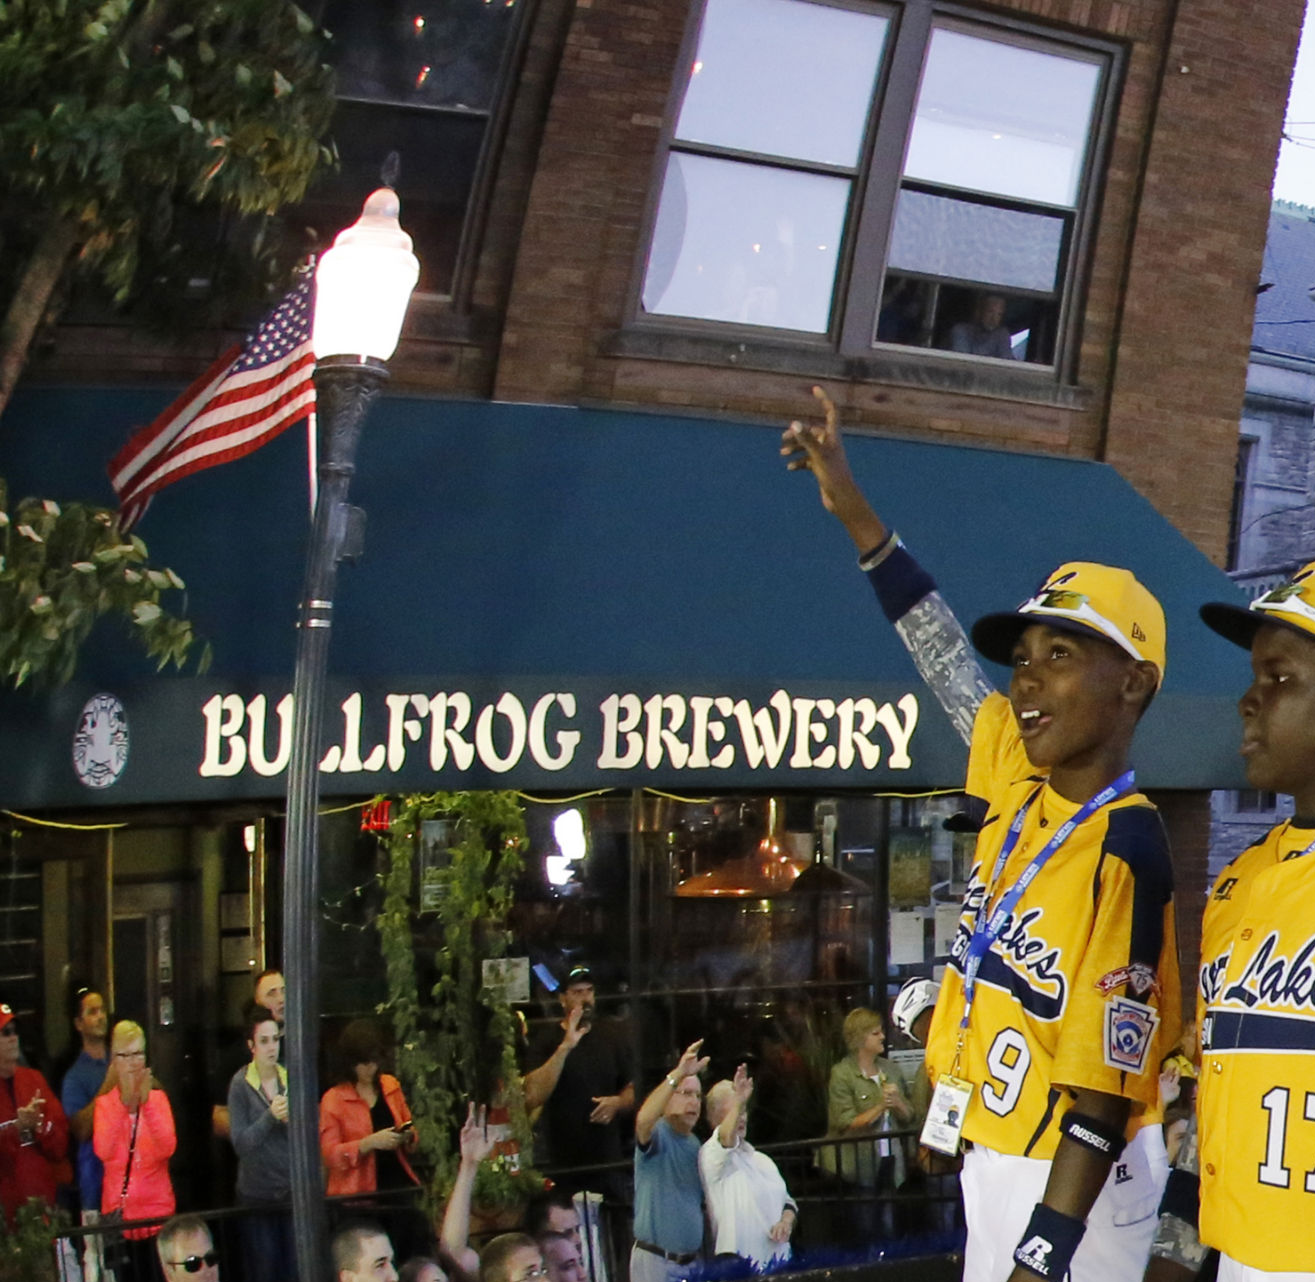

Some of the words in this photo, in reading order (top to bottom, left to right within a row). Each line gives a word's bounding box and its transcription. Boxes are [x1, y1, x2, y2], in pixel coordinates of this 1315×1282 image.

[200, 691, 581, 777] BULFROG
[597, 689, 918, 770] BREWERY
[981, 1026, 1031, 1118] 9
[1068, 1123, 1112, 1153] RUSSELL
